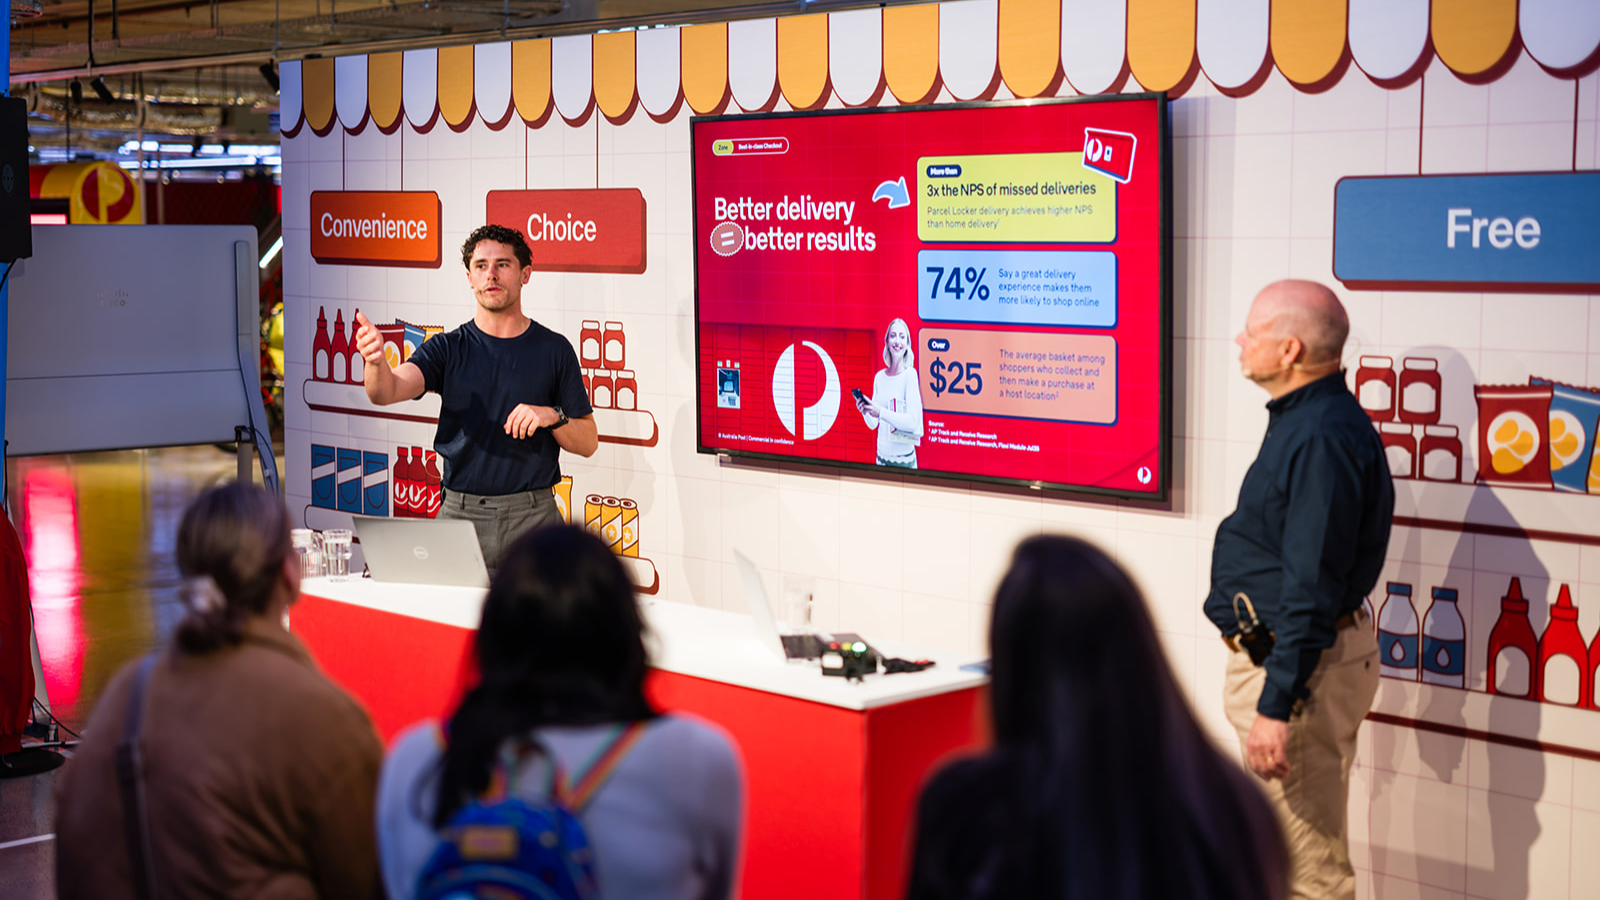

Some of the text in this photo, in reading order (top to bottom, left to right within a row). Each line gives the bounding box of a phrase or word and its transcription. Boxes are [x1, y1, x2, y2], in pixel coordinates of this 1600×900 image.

[927, 181, 1096, 197] 3x the NPS of missed deliveries
[714, 194, 855, 226] Better delivery
[927, 205, 1094, 216] Parcel Locker delivery achieves higher NPS
[320, 212, 427, 240] Convenience
[526, 212, 597, 242] Choice
[927, 220, 943, 228] than
[945, 219, 966, 228] home
[1447, 208, 1541, 249] Free
[744, 225, 804, 250] better
[807, 225, 876, 251] results
[998, 268, 1012, 280] Say
[1021, 270, 1042, 280] great
[1044, 269, 1076, 280] delivery
[926, 267, 990, 301] 74%
[998, 283, 1092, 292] experience makes them
[1020, 296, 1040, 306] likely
[1043, 297, 1050, 305] to
[1053, 296, 1073, 307] shop
[1074, 297, 1100, 307] online
[931, 341, 946, 349] Over
[1000, 349, 1105, 365] The average basket among
[929, 356, 983, 398] $25
[999, 363, 1100, 376] shoppers who collect and
[999, 376, 1016, 385] then
[1018, 377, 1039, 386] make
[1048, 379, 1084, 389] purchase
[1087, 382, 1094, 390] at
[1006, 389, 1022, 398] host
